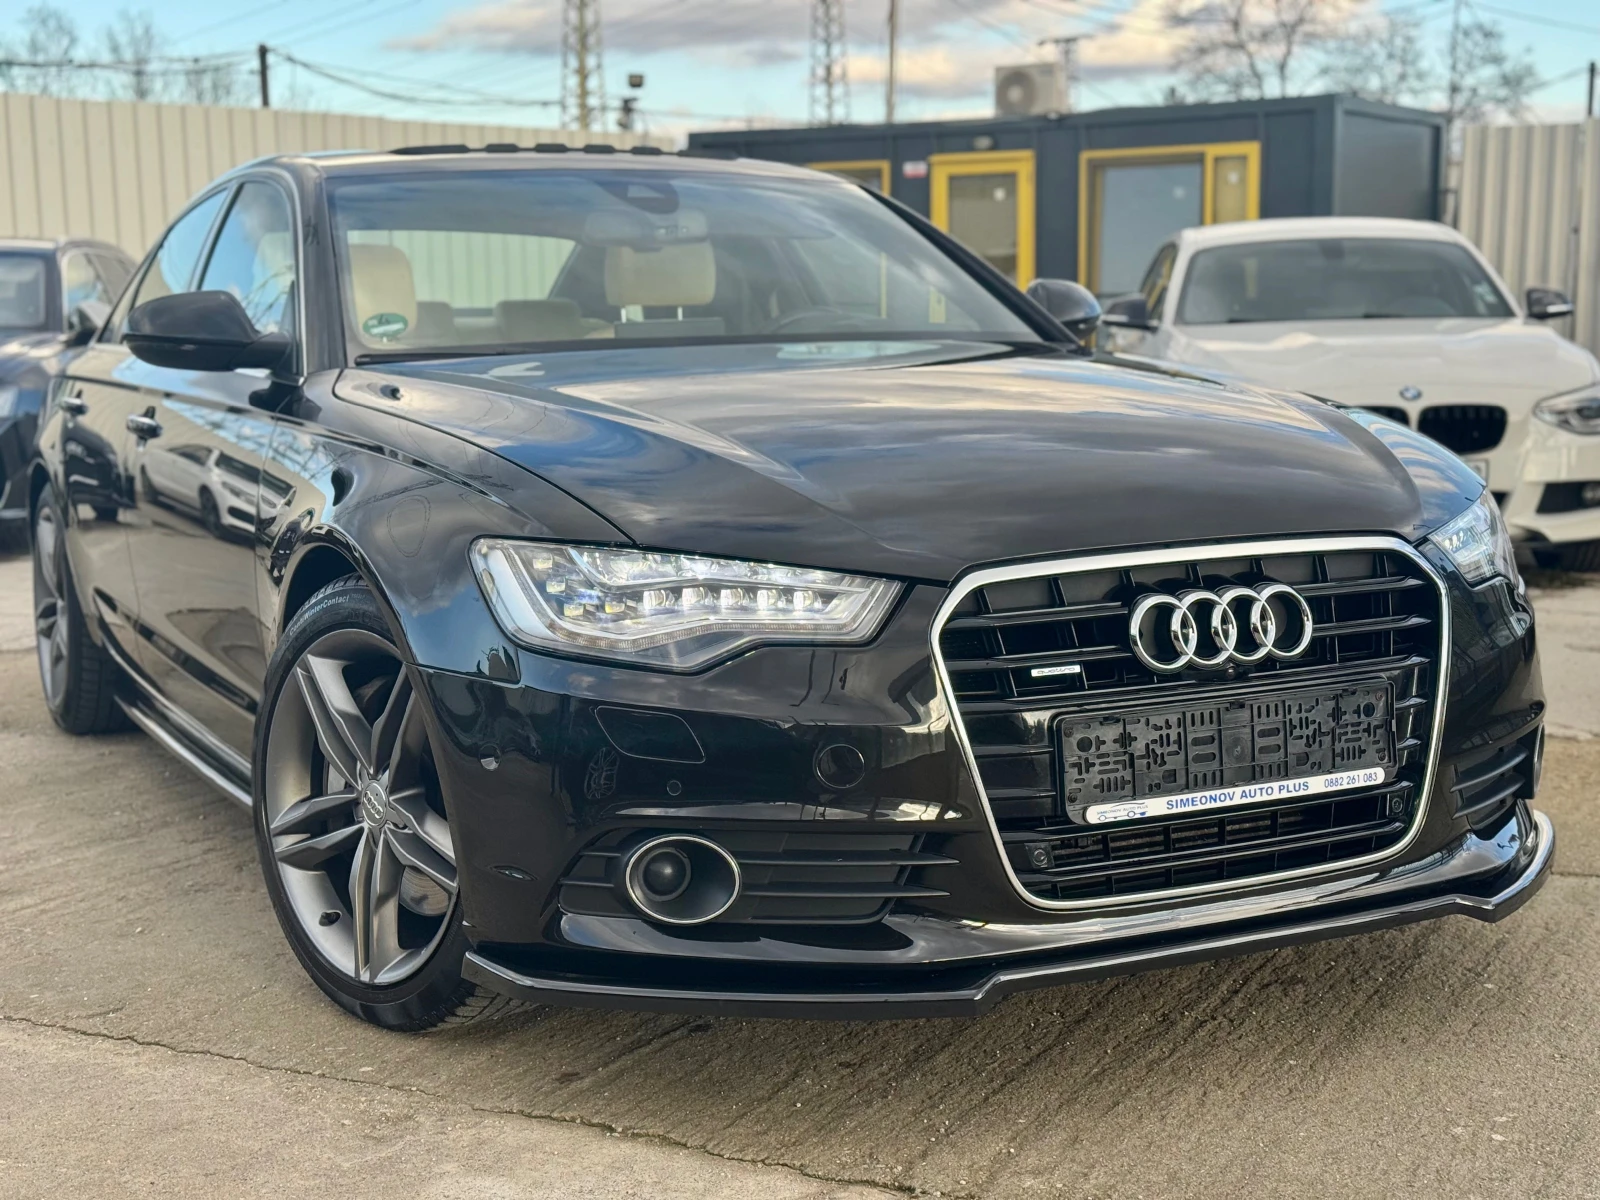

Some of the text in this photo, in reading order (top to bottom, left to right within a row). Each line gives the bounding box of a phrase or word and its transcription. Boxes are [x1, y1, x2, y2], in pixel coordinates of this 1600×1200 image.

[1324, 772, 1378, 789] 0882 261 083
[1166, 781, 1310, 810] SIMEONOV AUTO PLUS
